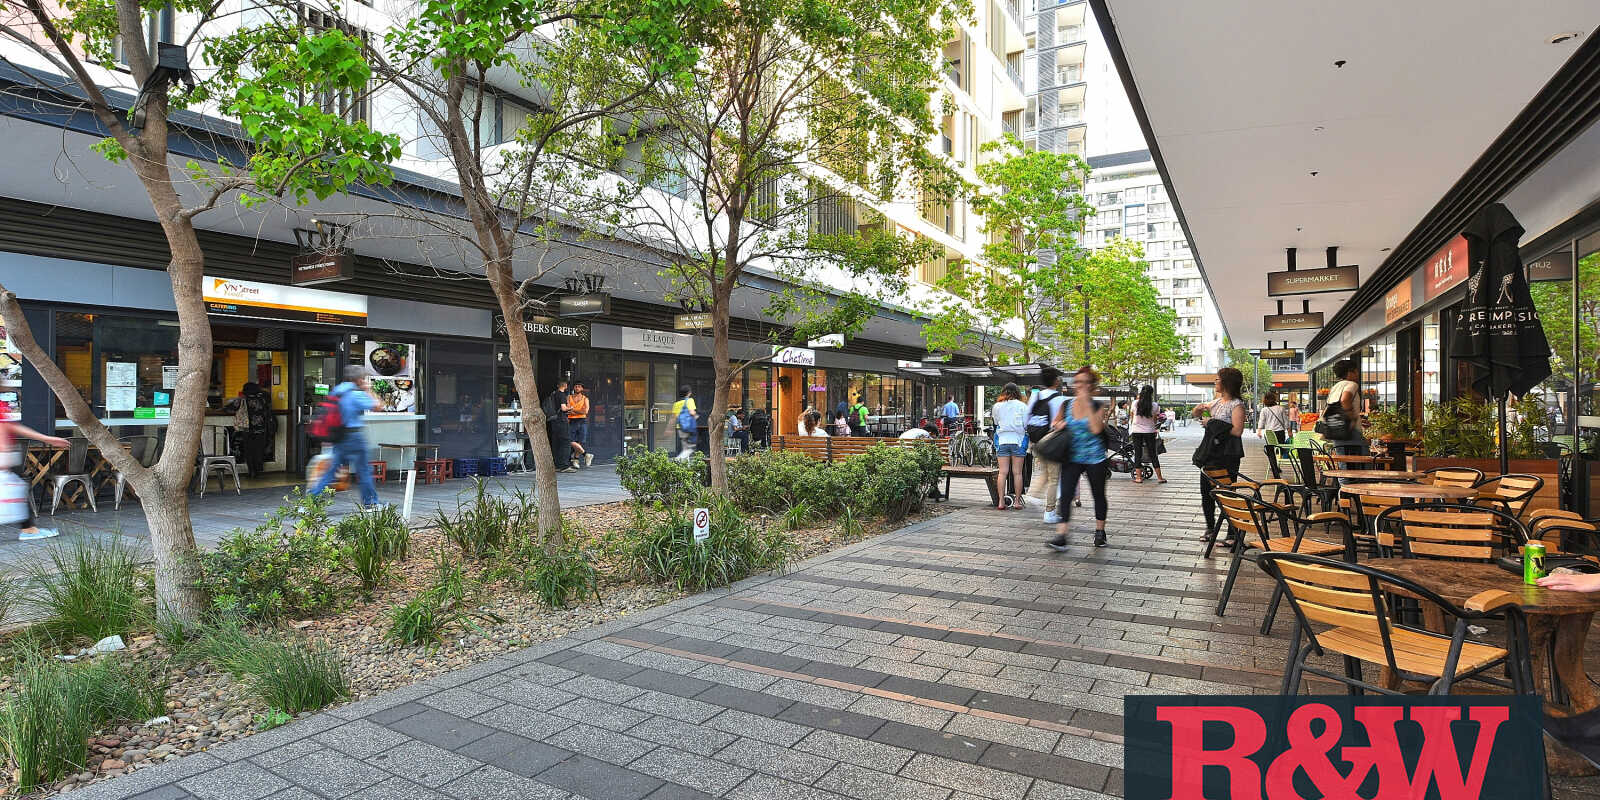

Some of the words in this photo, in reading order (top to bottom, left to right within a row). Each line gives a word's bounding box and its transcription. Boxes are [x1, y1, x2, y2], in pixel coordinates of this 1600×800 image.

[1286, 274, 1339, 284] SUPERMARKET
[551, 325, 579, 337] CREEK
[642, 333, 652, 342] LE
[653, 335, 676, 346] LAQUE
[782, 349, 814, 365] Chatime
